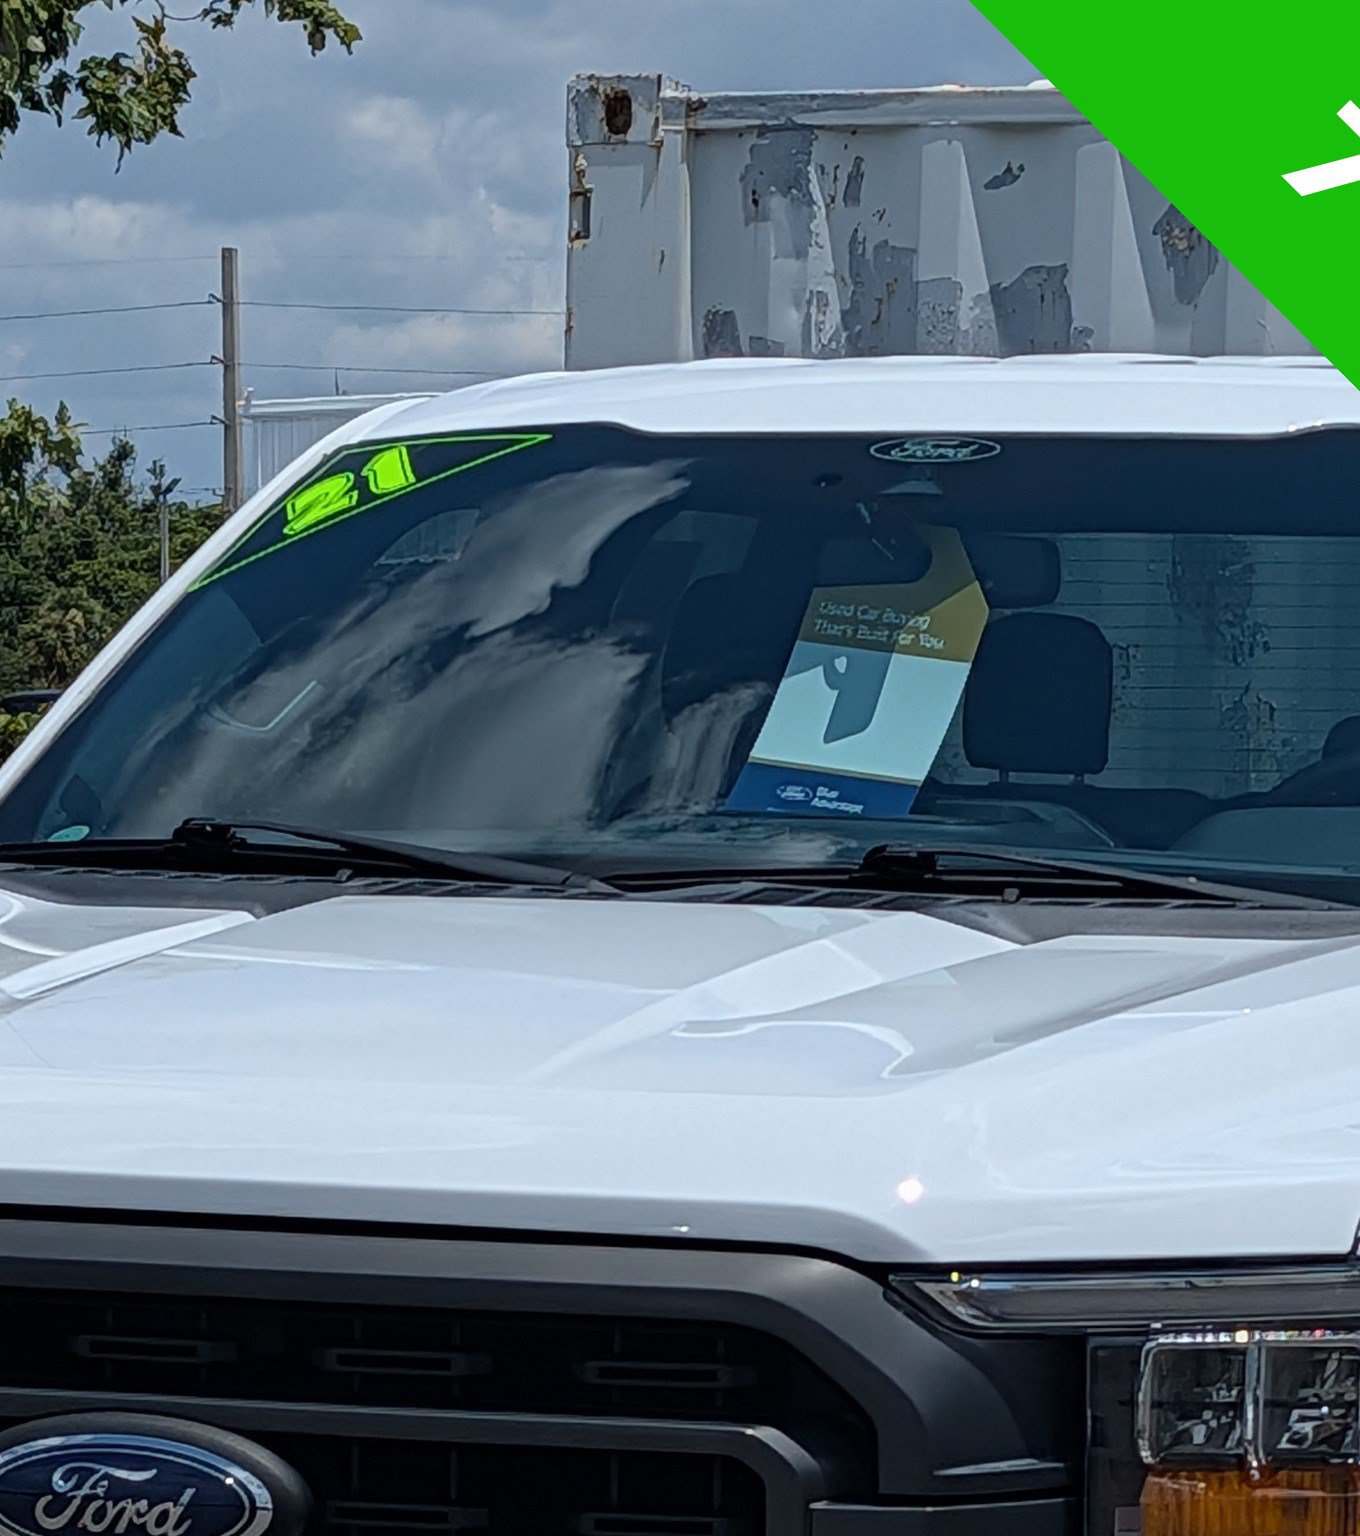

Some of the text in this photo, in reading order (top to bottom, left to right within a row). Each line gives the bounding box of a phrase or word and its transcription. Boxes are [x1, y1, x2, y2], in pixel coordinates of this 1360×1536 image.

[890, 440, 980, 459] Ford
[283, 444, 417, 535] 21
[35, 1462, 195, 1536] Ford
